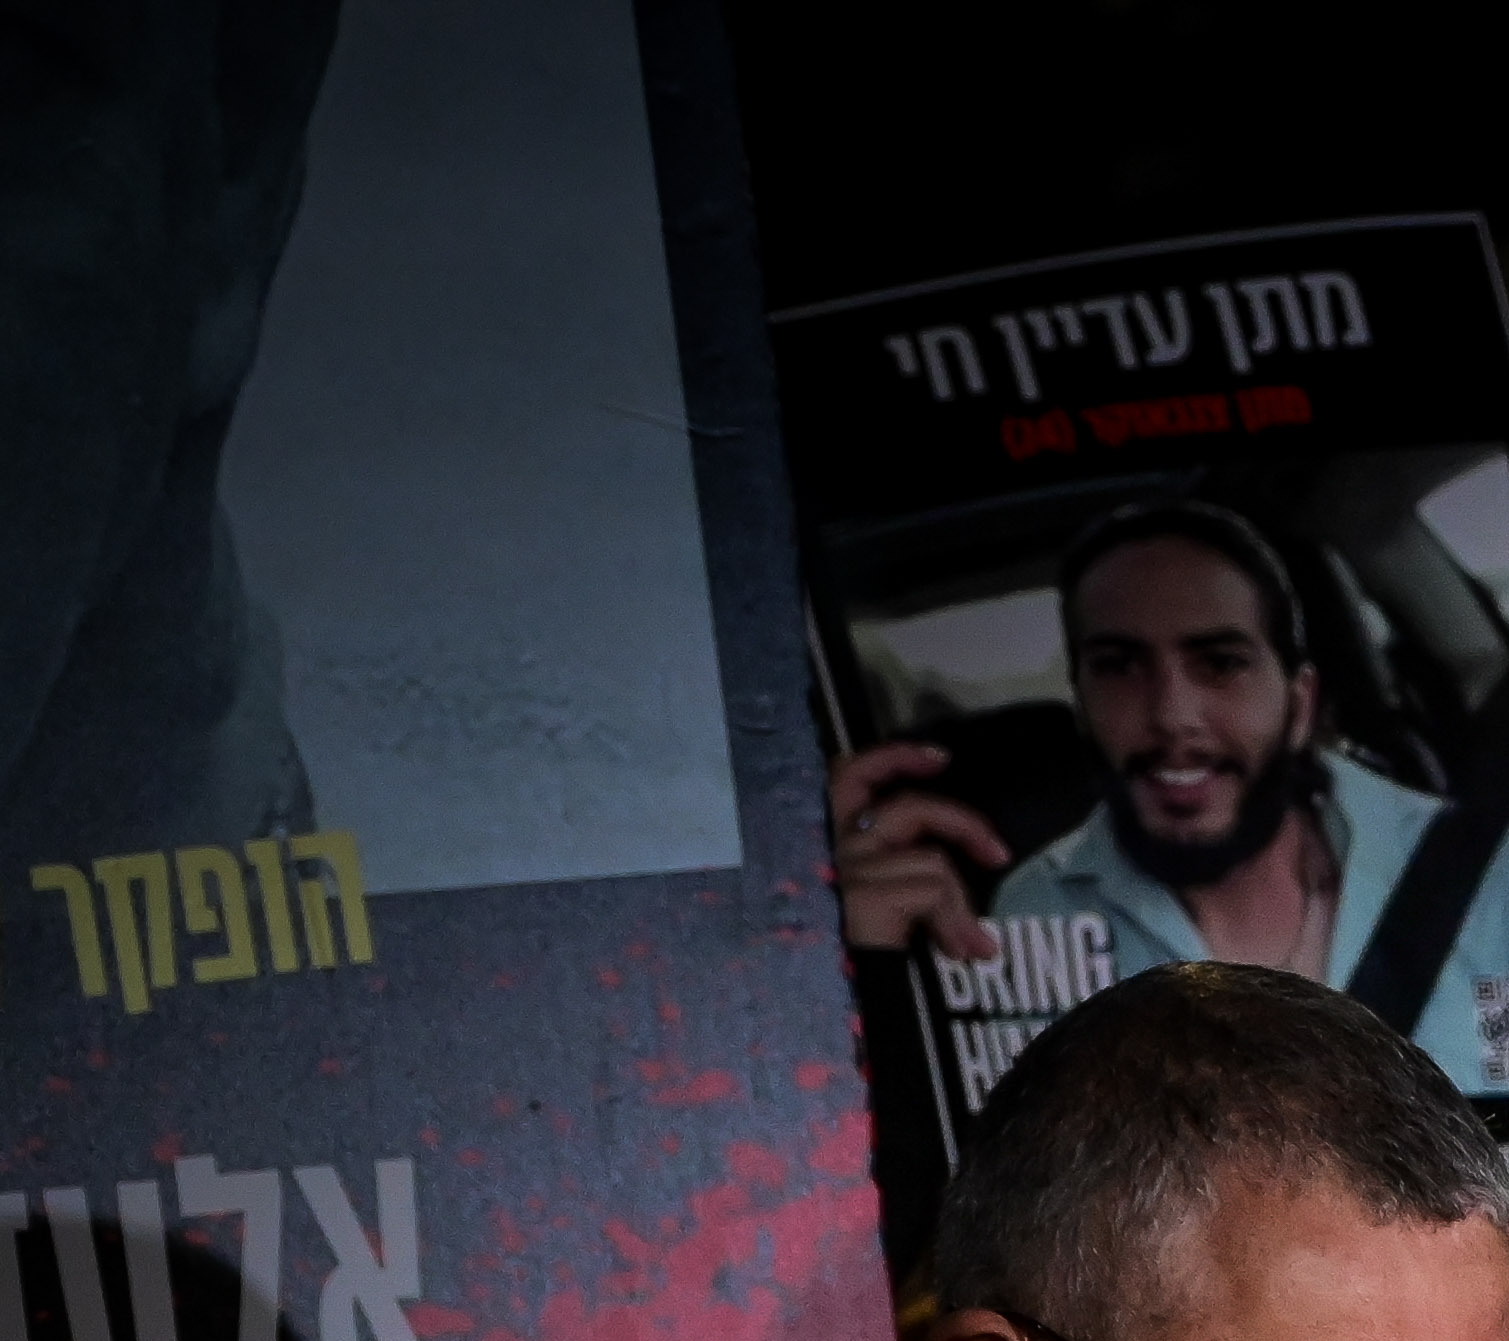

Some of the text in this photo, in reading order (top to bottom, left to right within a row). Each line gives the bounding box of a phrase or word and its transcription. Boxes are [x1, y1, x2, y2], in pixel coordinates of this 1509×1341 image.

[884, 270, 1373, 402] מתן עדיין חי
[30, 829, 376, 1016] הופקר
